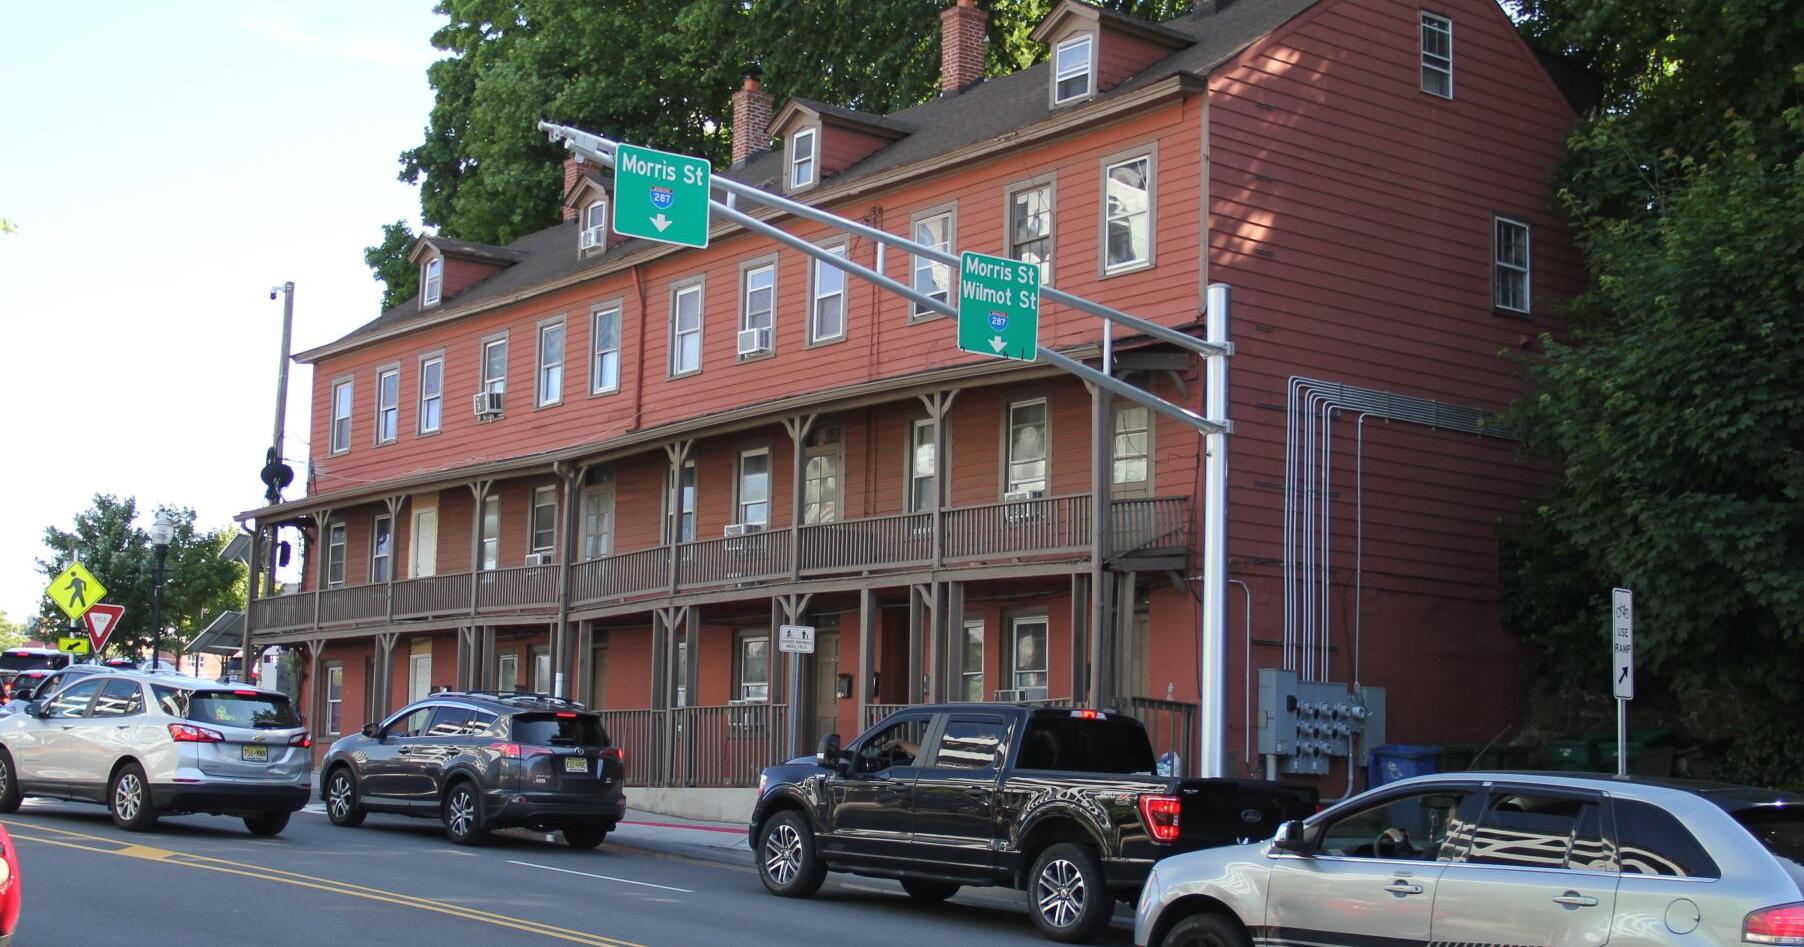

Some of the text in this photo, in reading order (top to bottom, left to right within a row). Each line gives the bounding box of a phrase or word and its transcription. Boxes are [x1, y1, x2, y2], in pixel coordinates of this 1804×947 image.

[622, 152, 704, 186] Morris St
[654, 193, 671, 203] 287
[966, 255, 1035, 286] Morris St
[962, 279, 1037, 310] Wilmot St
[991, 316, 1006, 327] 287
[1617, 627, 1629, 638] USE
